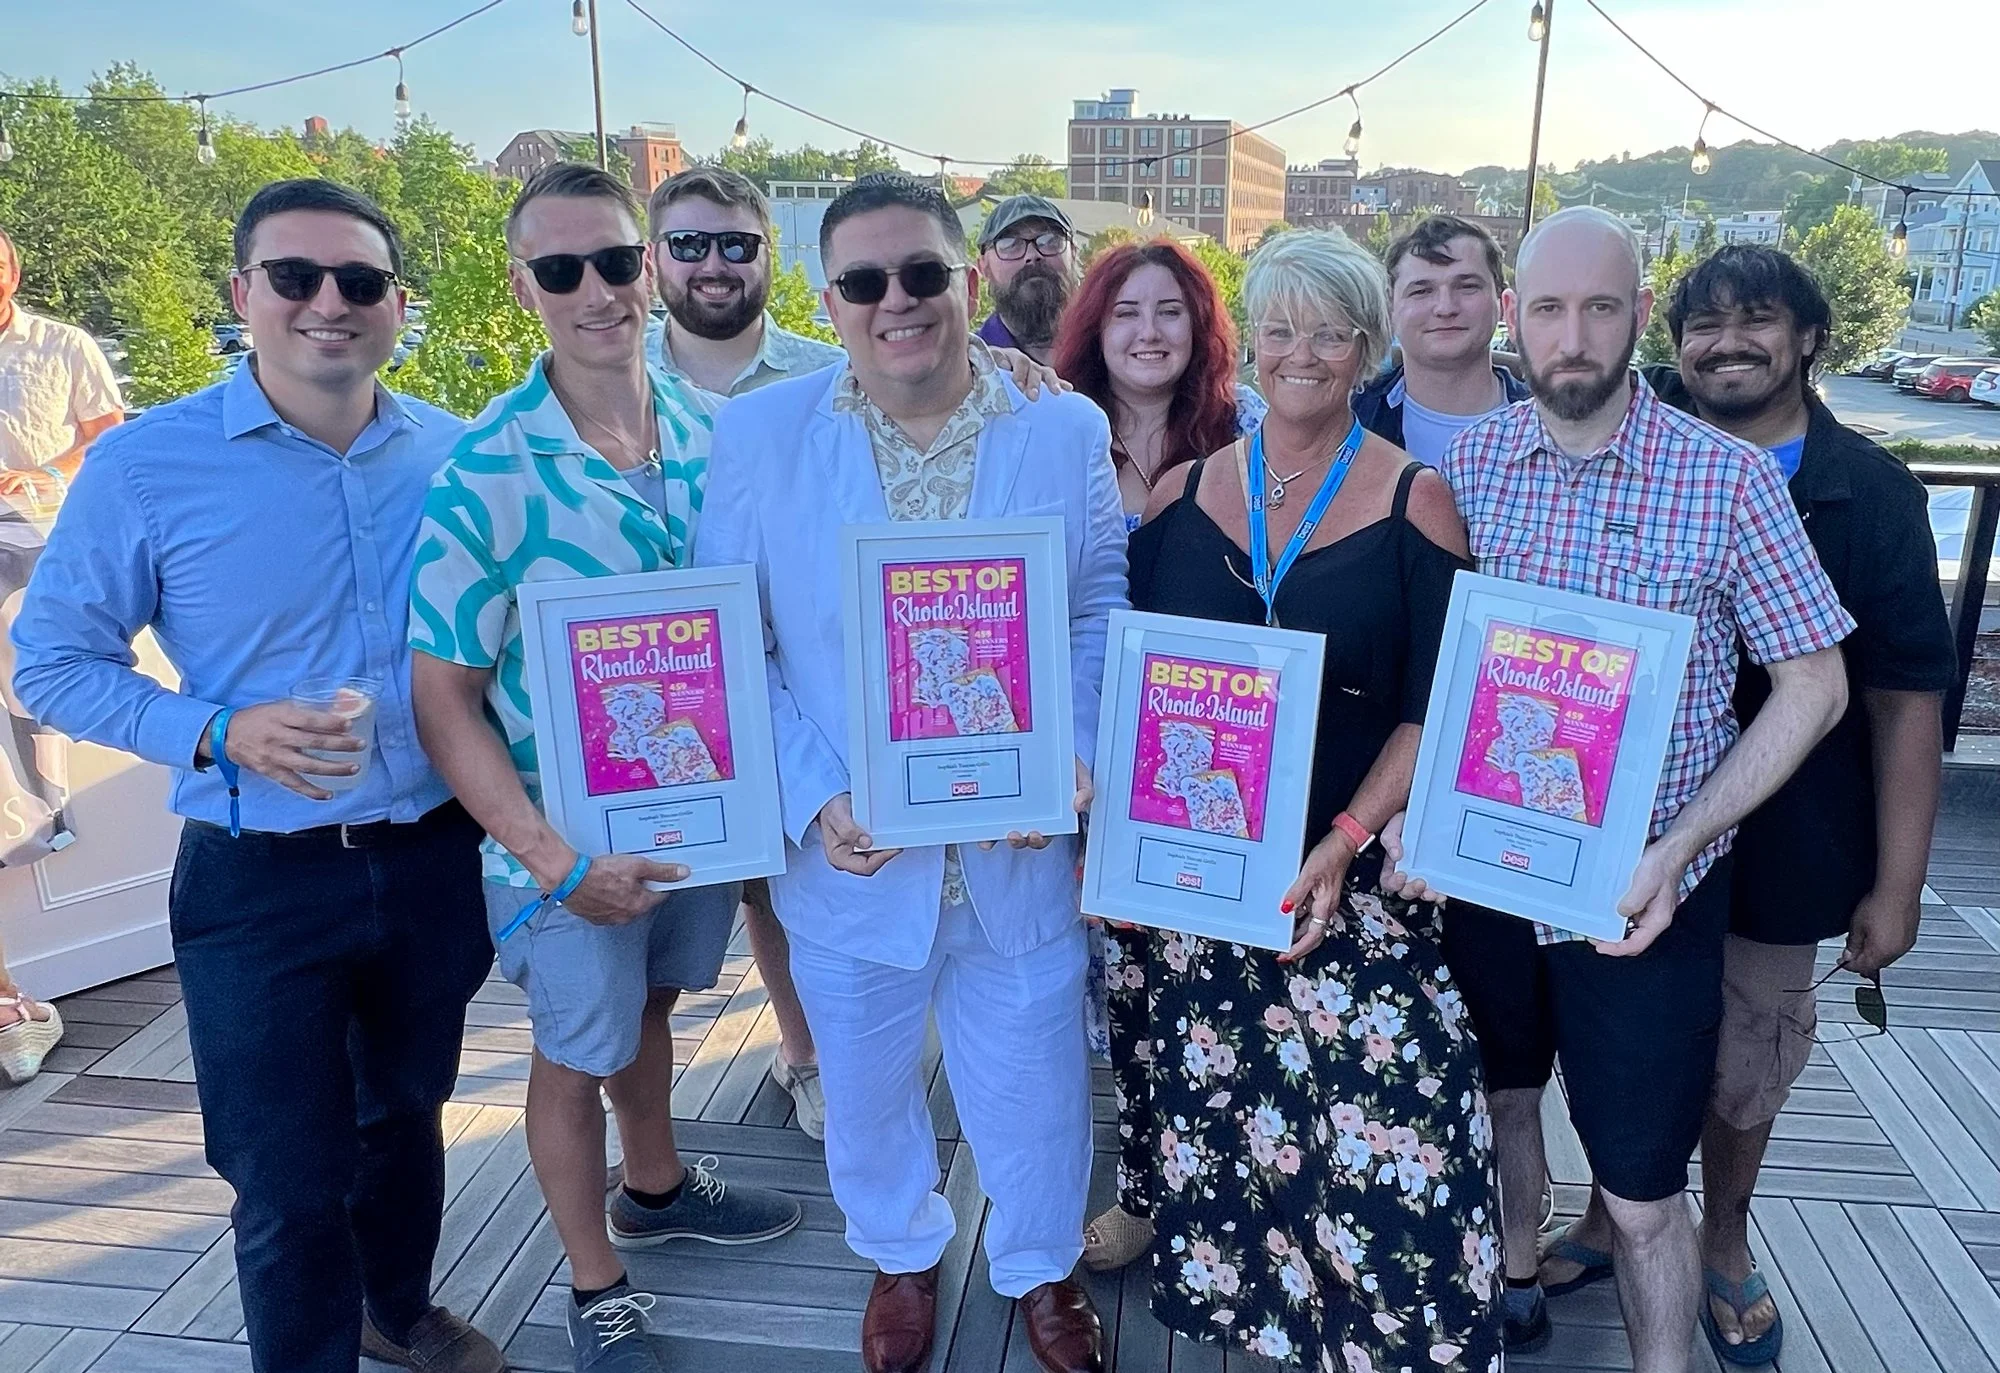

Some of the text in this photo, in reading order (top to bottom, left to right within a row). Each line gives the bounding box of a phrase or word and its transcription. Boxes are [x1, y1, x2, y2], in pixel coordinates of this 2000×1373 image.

[890, 566, 1018, 595] BEST OF
[892, 592, 1021, 627] Rhode Island
[577, 618, 711, 653] BEST OF
[1492, 629, 1629, 677] BEST OF
[580, 642, 717, 684] Rhode Island
[1150, 661, 1273, 699] BEST OF
[1486, 655, 1622, 708] Rhode Island
[1148, 686, 1269, 727] Rhode Island
[952, 783, 978, 794] best
[655, 832, 681, 844] best
[1502, 851, 1529, 868] best
[1178, 873, 1201, 887] best
